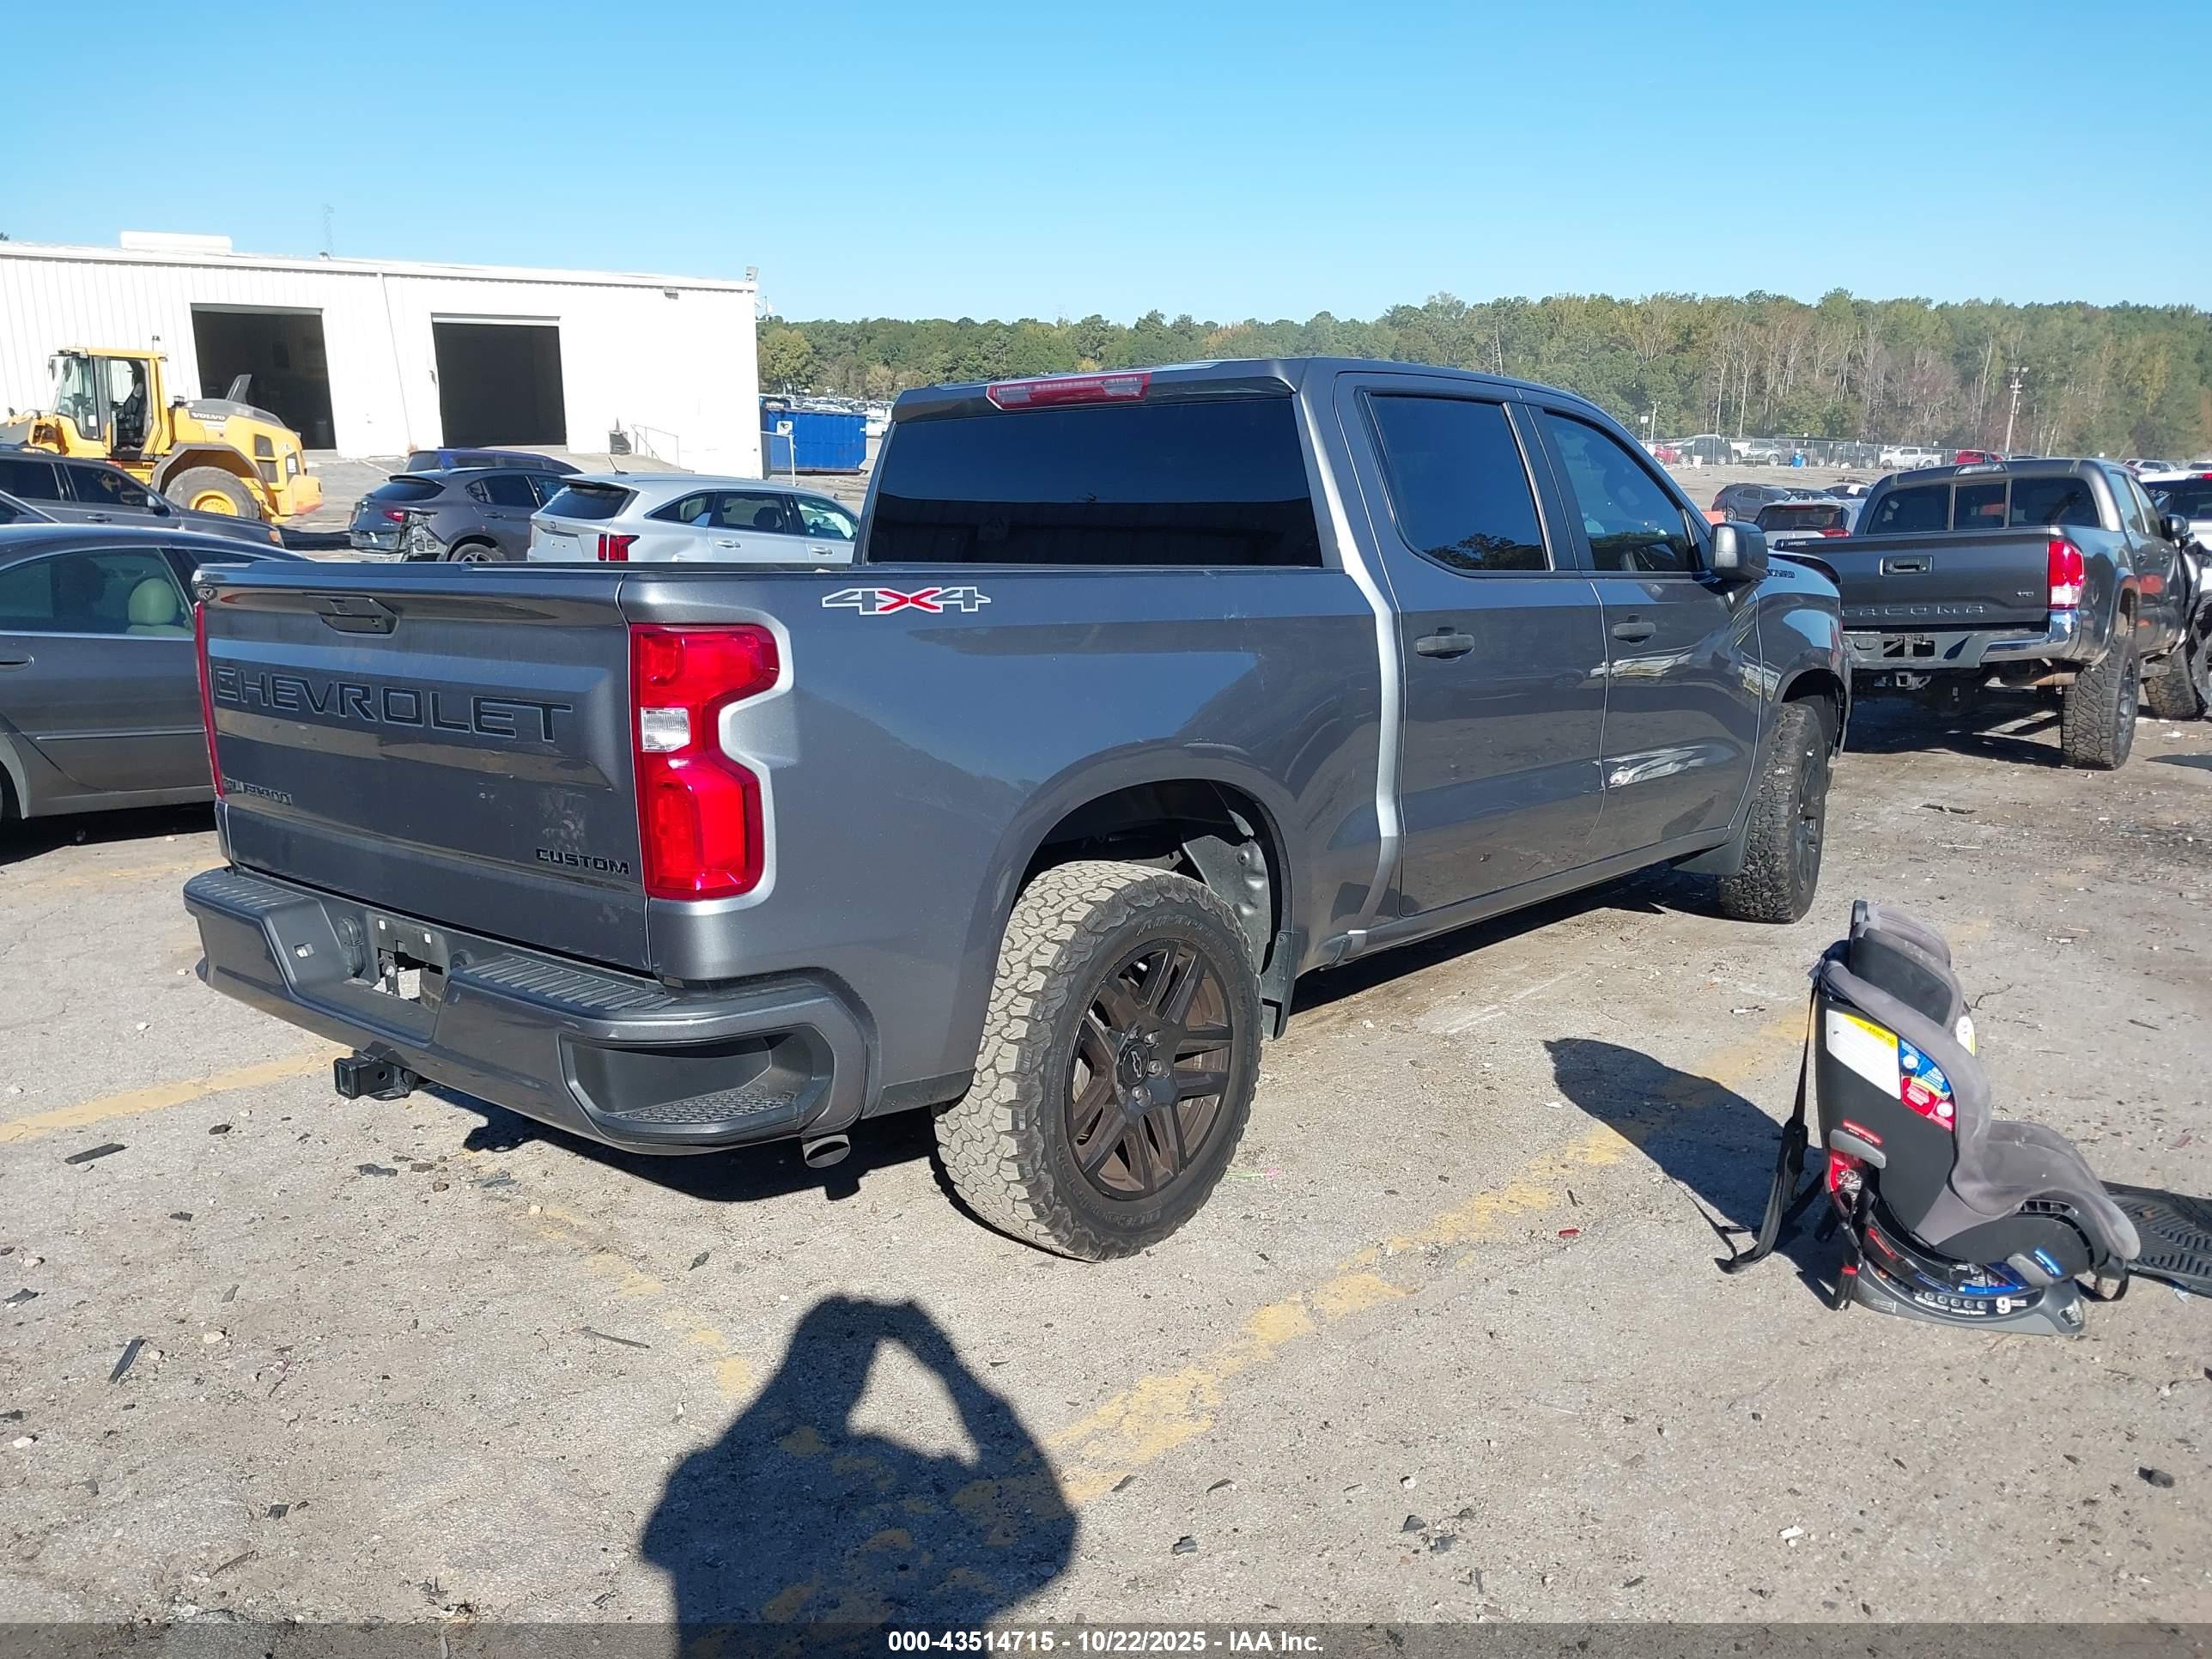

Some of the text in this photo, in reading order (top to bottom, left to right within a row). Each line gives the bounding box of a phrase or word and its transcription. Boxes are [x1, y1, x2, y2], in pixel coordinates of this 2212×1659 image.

[191, 411, 226, 421] VOLVO
[1841, 605, 1988, 617] TACOMA
[214, 665, 574, 743] CHEVROLET
[535, 847, 631, 875] CUSTOM
[1996, 1297, 2011, 1315] 9
